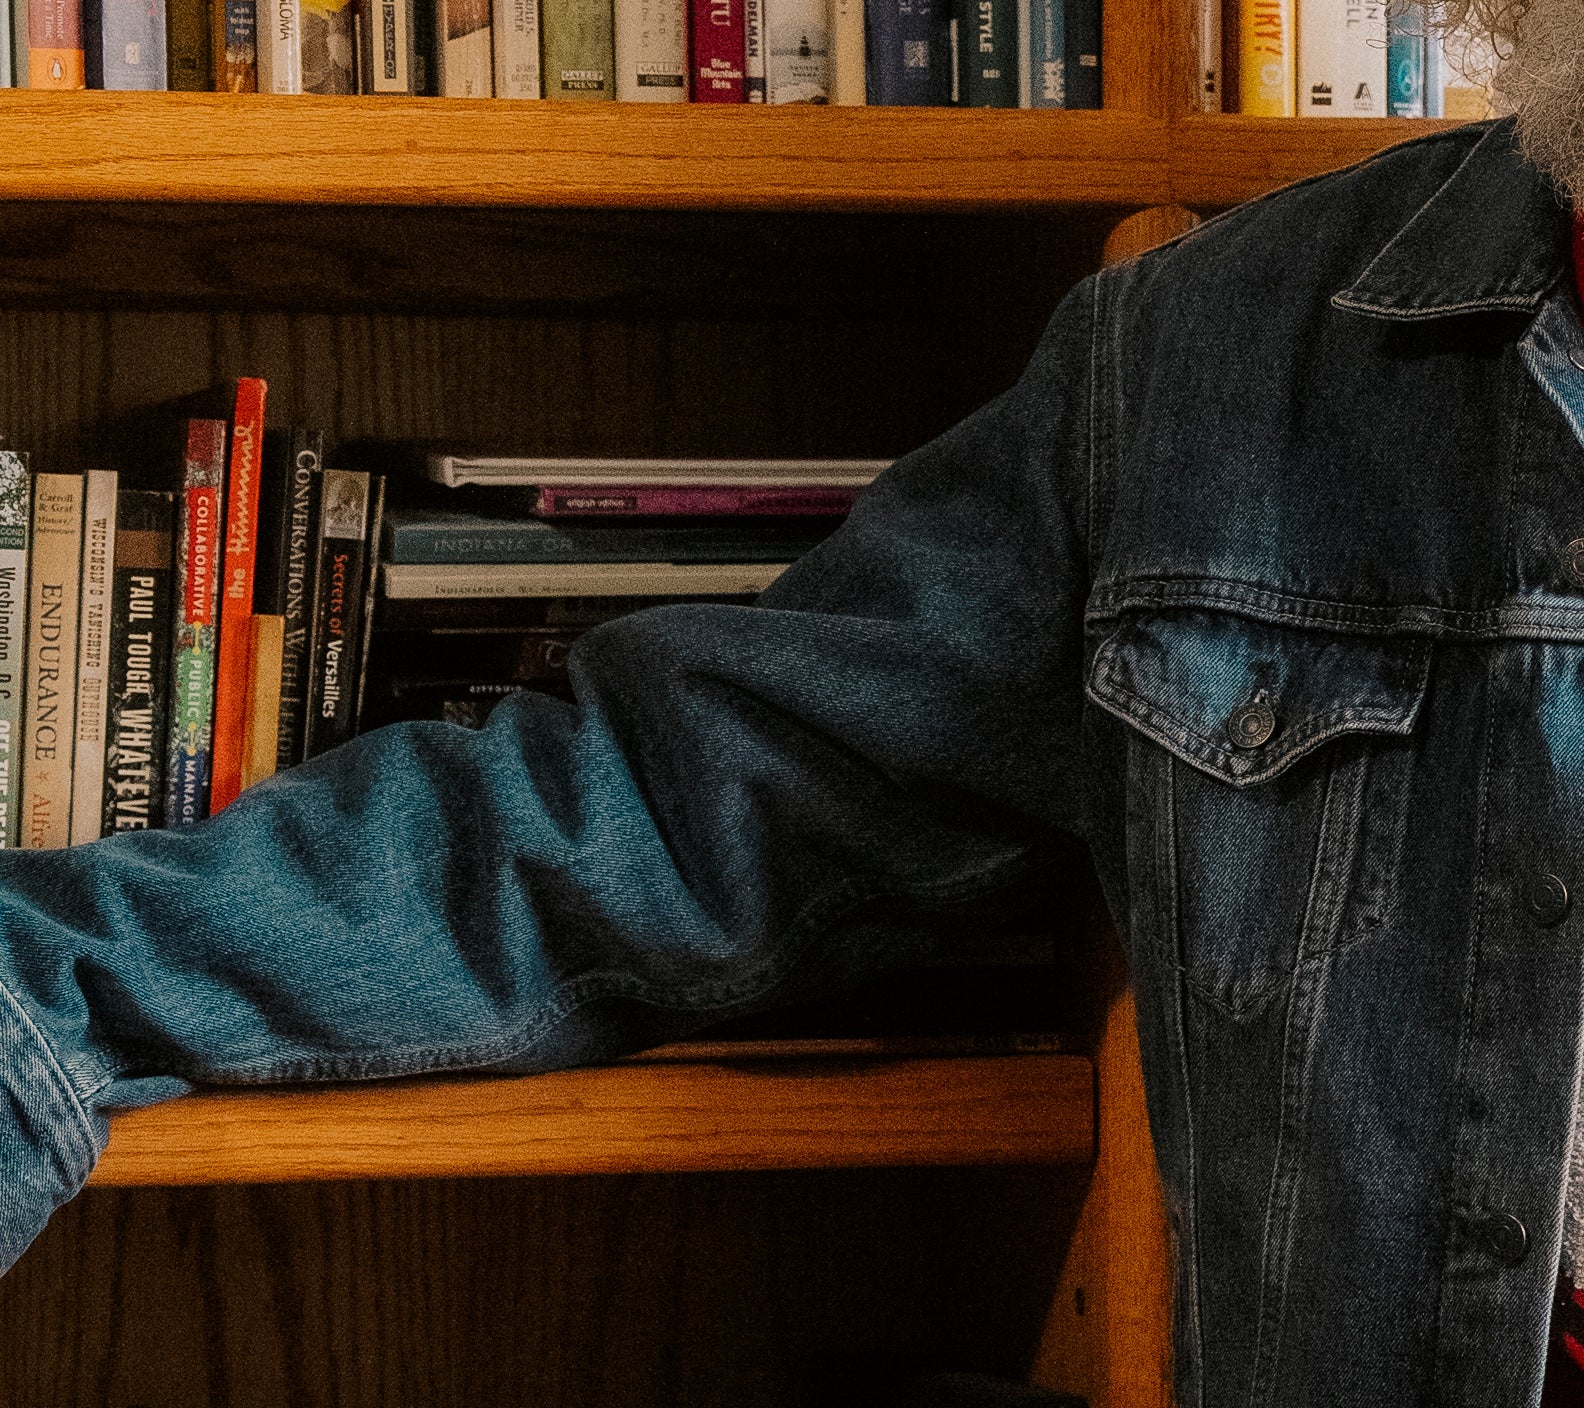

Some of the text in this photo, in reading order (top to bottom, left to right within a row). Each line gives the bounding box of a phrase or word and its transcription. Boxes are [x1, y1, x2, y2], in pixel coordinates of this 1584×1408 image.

[34, 583, 63, 761] ENDURANCE
[128, 575, 155, 623] PAUL
[182, 496, 209, 824] COLLABORATIVE PUBLIC MANAGE
[322, 553, 348, 719] Secrets of Versailles
[115, 710, 152, 831] WHATEVE
